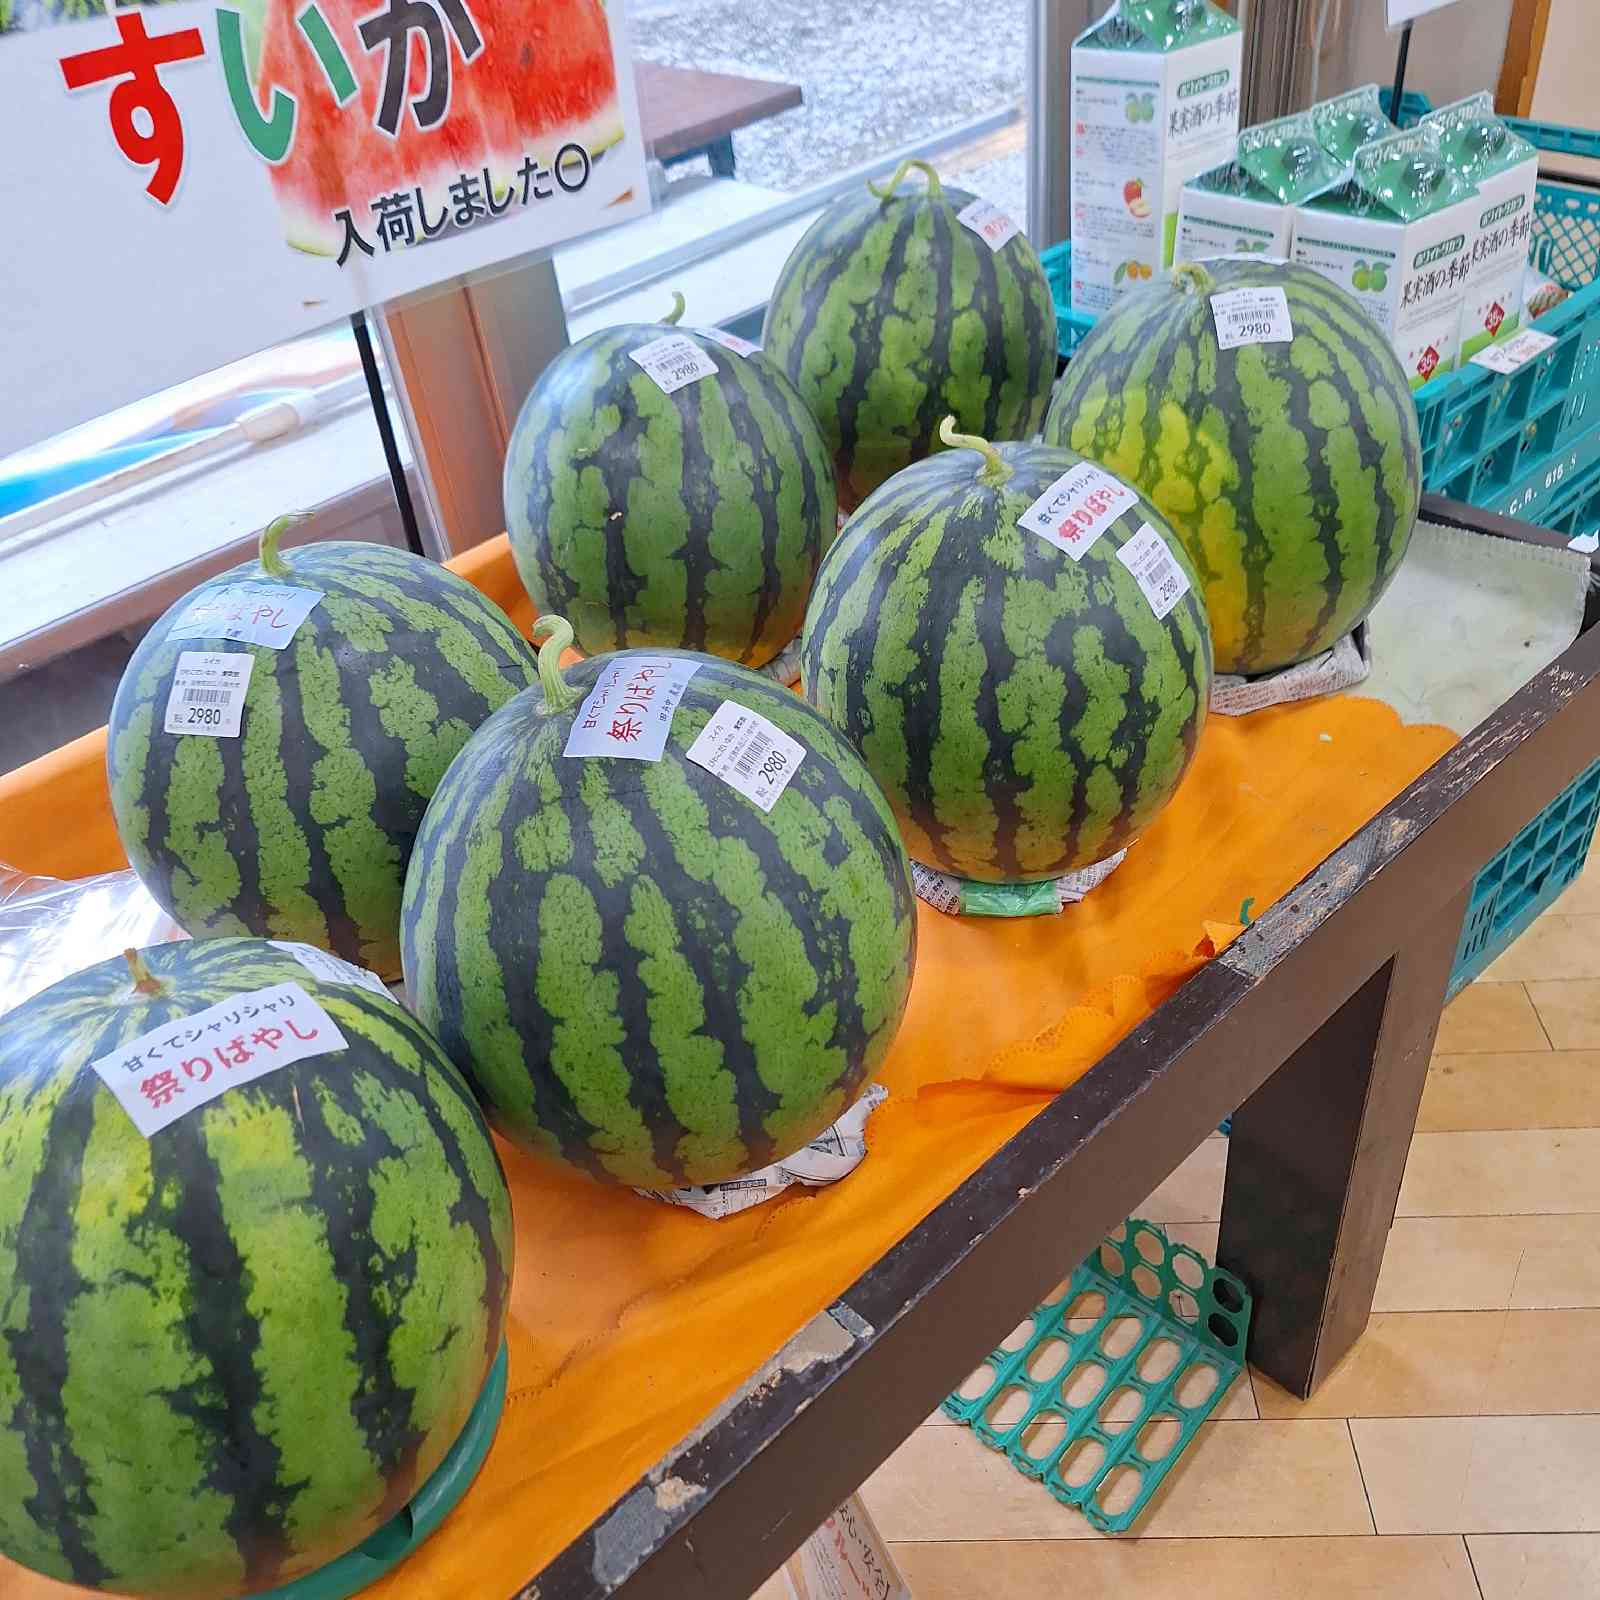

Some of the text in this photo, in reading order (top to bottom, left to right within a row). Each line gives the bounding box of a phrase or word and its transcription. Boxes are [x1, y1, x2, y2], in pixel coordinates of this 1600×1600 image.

[58, 0, 484, 206] すいか
[1400, 251, 1470, 309] 果実酒の季節
[1238, 322, 1271, 337] 2980
[671, 361, 699, 380] 2980
[1057, 484, 1126, 543] 祭りばやし
[187, 707, 221, 725] 2980
[606, 662, 672, 743] 祭りばやし
[758, 750, 788, 785] 2980
[121, 994, 296, 1073] 甘くてシャリシャリ
[139, 1019, 319, 1109] 祭りばやし
